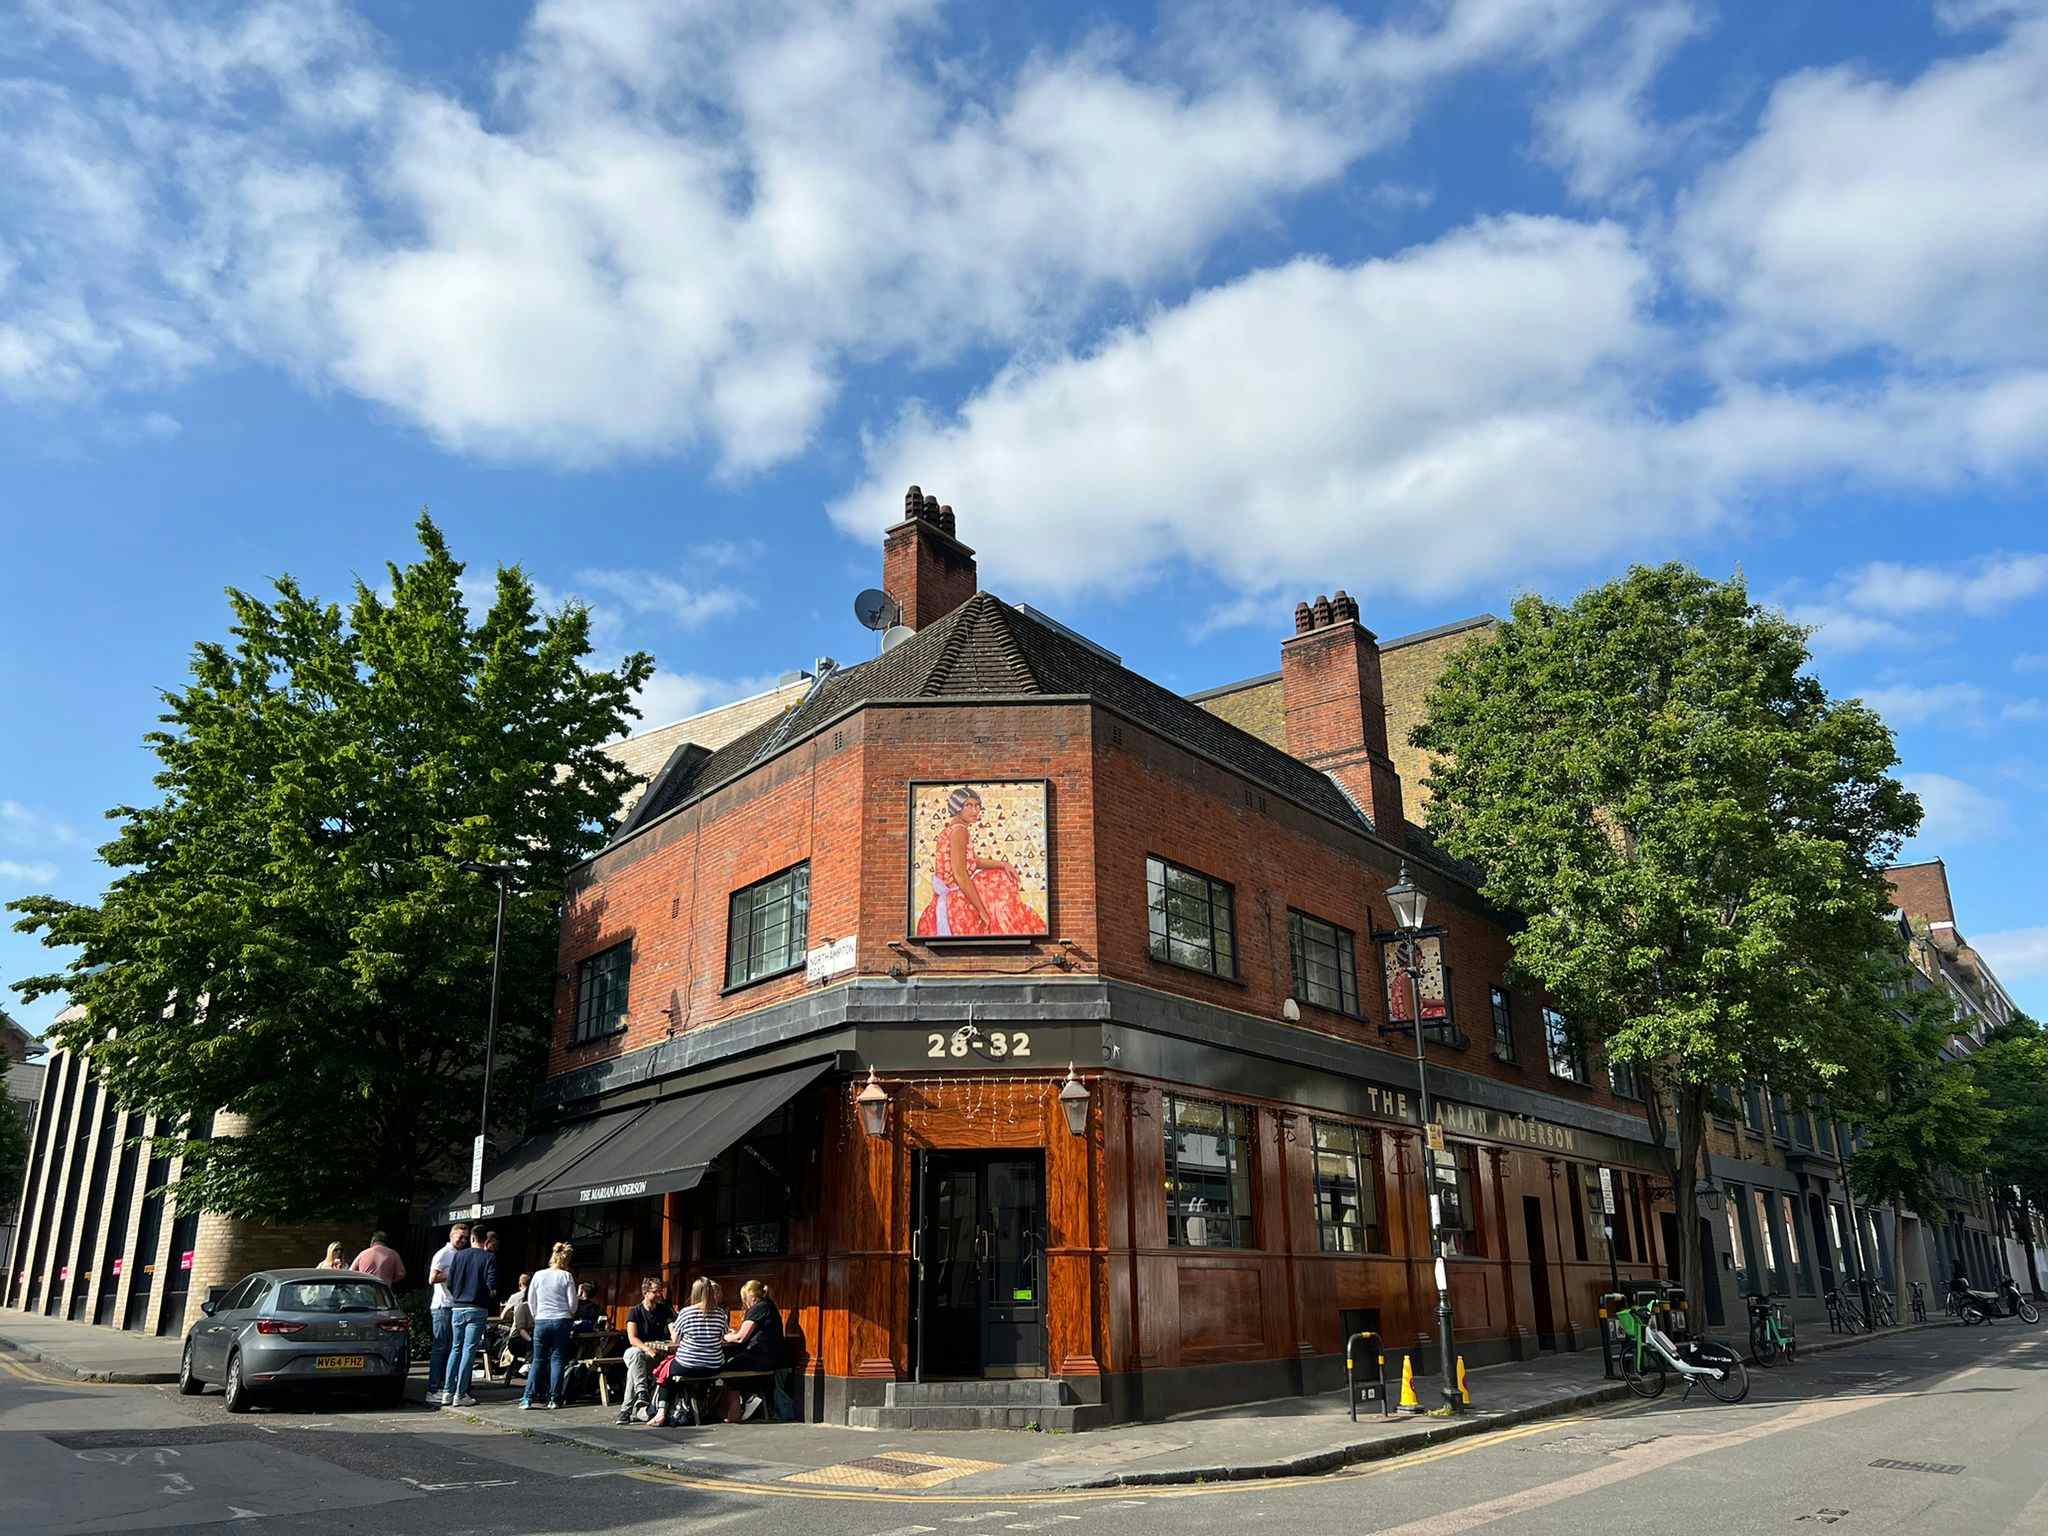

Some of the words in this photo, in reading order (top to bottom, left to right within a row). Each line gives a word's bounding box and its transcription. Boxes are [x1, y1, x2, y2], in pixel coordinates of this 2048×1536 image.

[927, 1032, 1031, 1058] 28-32
[1367, 1086, 1408, 1118] THE
[1497, 1116, 1574, 1151] ANDERSON
[579, 1189, 591, 1202] THE
[591, 1185, 615, 1201] MARIAN
[614, 1180, 648, 1198] ANDERSON
